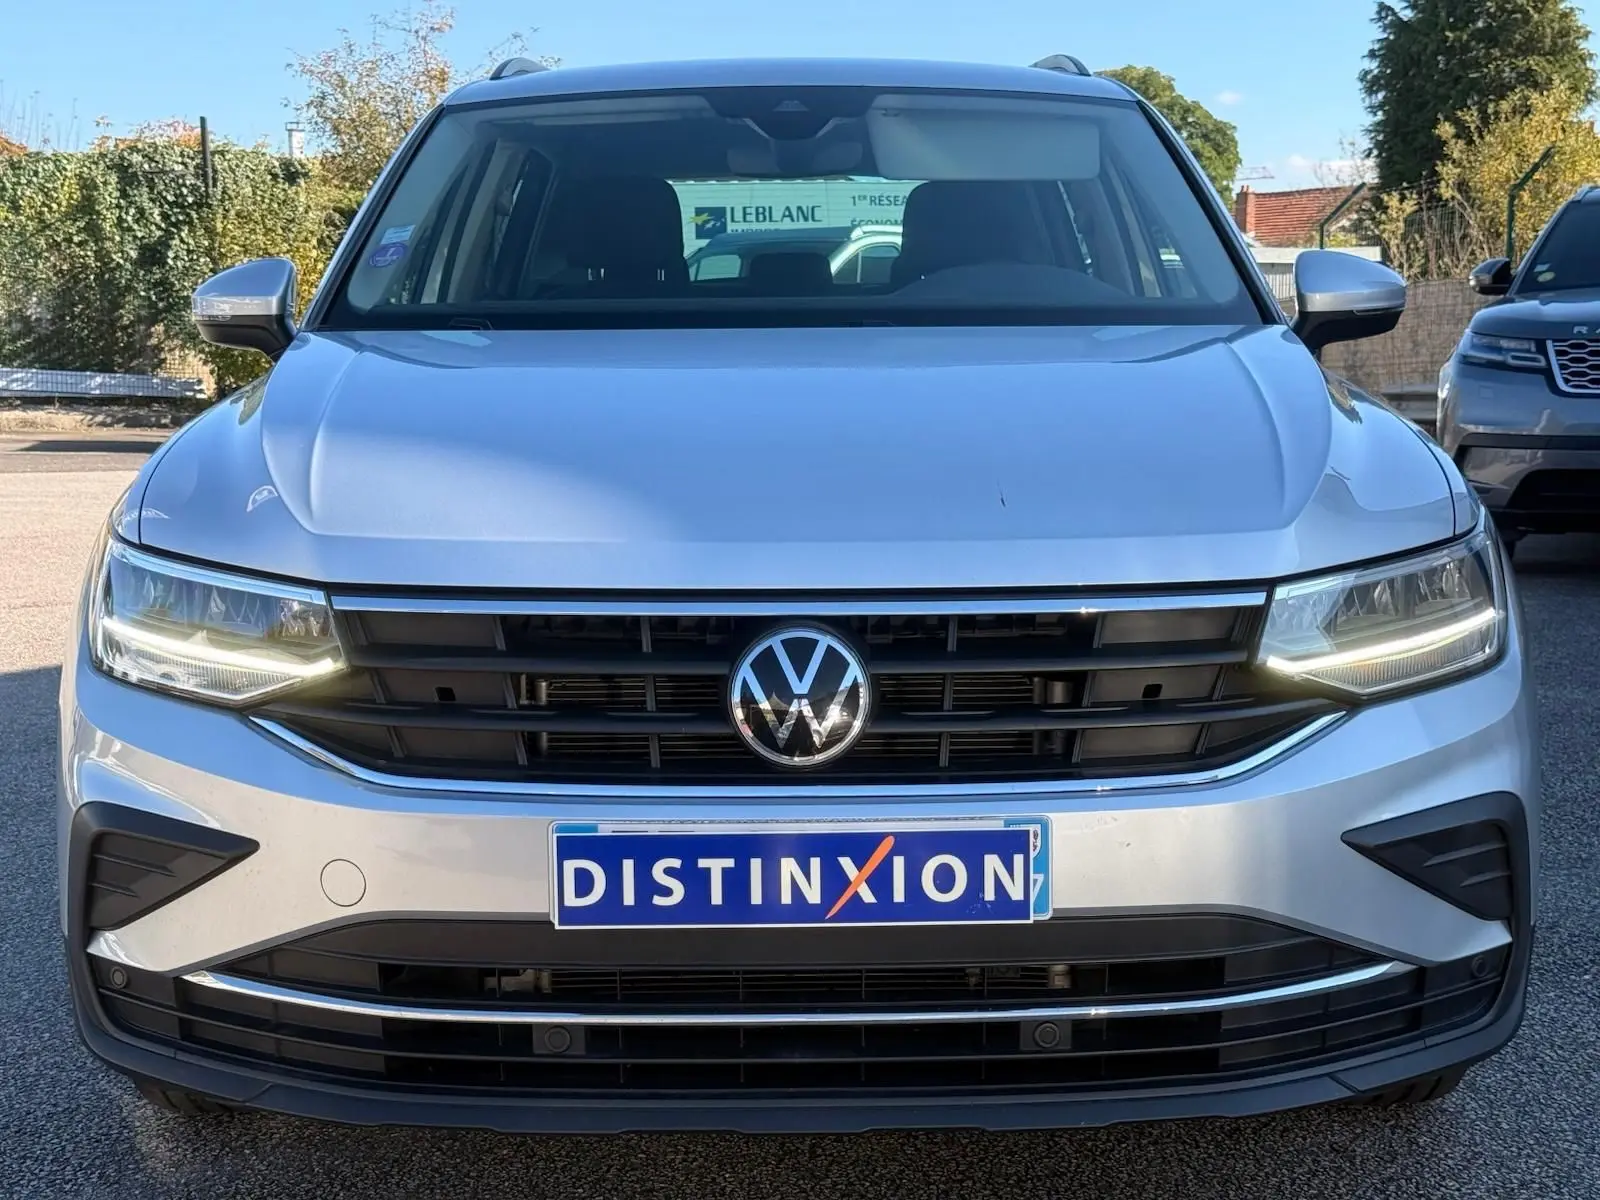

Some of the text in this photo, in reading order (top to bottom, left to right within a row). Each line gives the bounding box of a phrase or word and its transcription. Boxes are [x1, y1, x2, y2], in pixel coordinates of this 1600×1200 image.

[729, 205, 823, 223] LEBLANC
[1573, 325, 1600, 335] R
[562, 836, 1025, 919] DISTINXION
